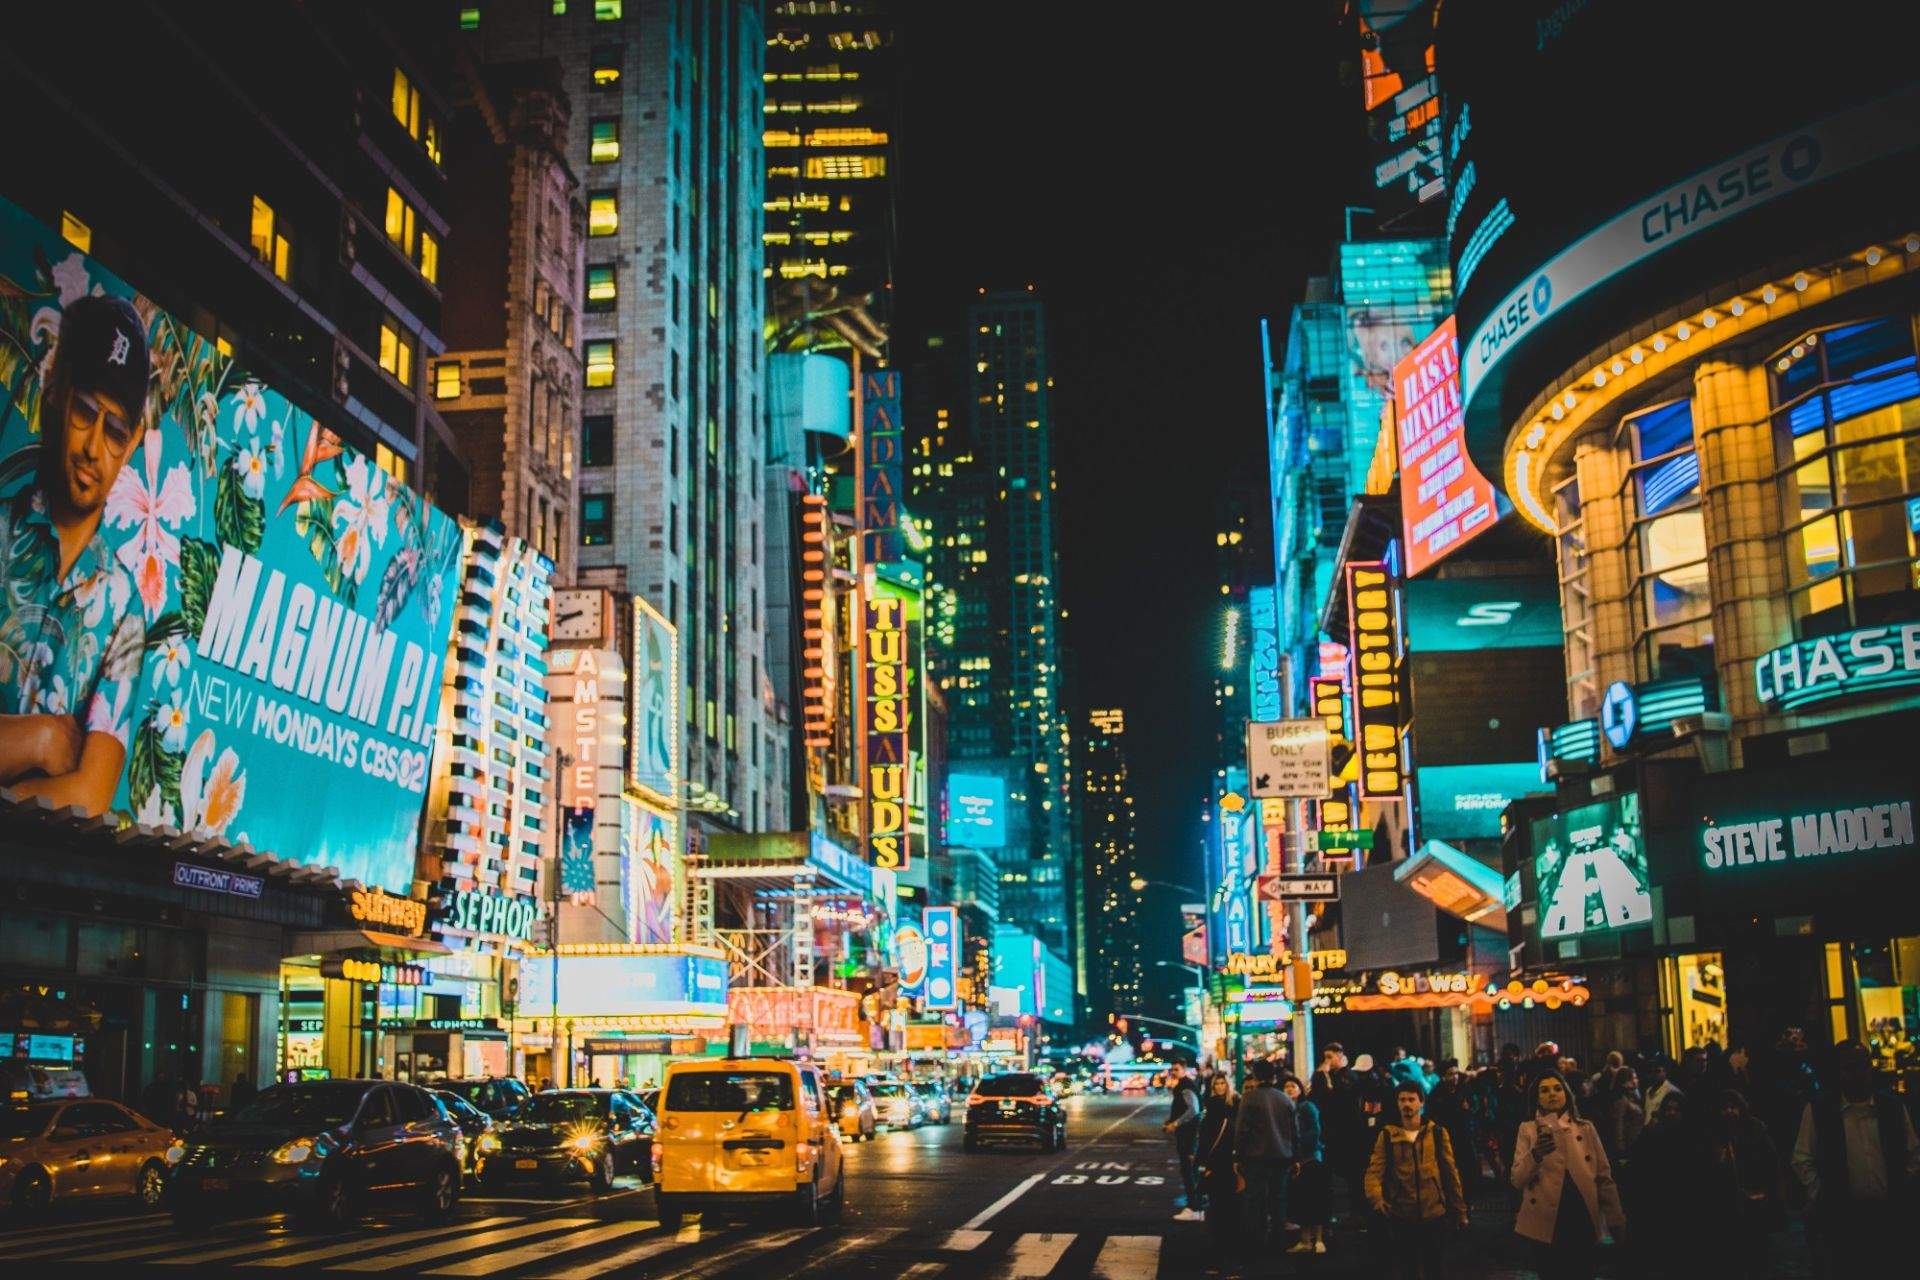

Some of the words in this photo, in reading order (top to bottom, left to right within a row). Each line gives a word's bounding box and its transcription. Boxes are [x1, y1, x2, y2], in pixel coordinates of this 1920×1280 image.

[1641, 156, 1773, 246] CHASE
[1480, 293, 1531, 366] CHASE
[197, 544, 398, 727] MAGNUM
[1354, 569, 1394, 709] VICTORY
[189, 669, 253, 730] NEW
[251, 695, 357, 769] MONDAYS
[869, 598, 903, 868] TUSSAUDS
[1266, 726, 1311, 739] BUSES
[1270, 744, 1305, 757] ONLY
[1364, 722, 1400, 794] NEW
[1703, 818, 1787, 869] STEVE
[1790, 801, 1915, 858] MADDEN
[177, 865, 230, 892] OUTFRONT
[233, 875, 263, 897] PRIME
[1269, 883, 1291, 894] ONE
[1303, 882, 1328, 892] WAY
[1379, 971, 1481, 997] Subway
[1051, 1174, 1165, 1185] BUS
